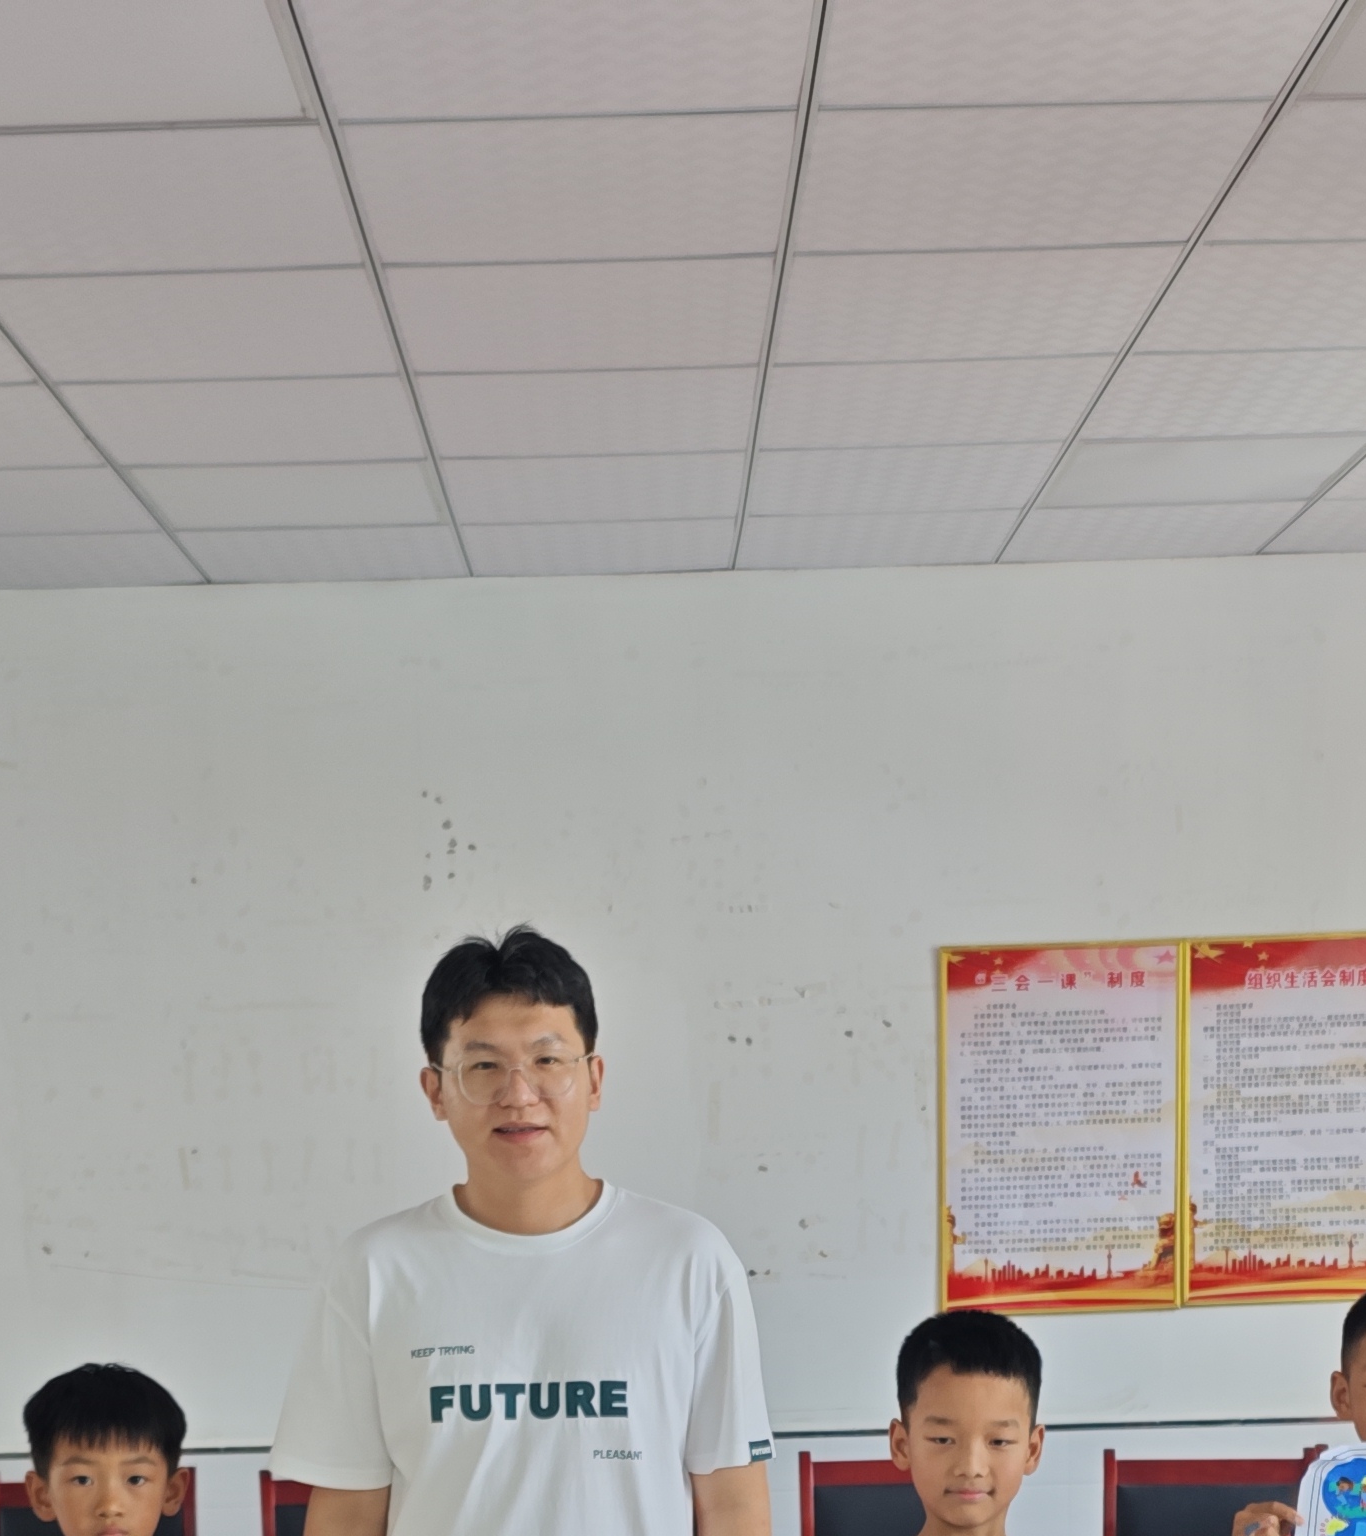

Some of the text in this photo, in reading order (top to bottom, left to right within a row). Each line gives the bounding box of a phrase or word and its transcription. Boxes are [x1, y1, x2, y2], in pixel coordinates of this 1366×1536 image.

[411, 1345, 475, 1359] KEEP TRYING
[430, 1381, 628, 1423] FUTURE
